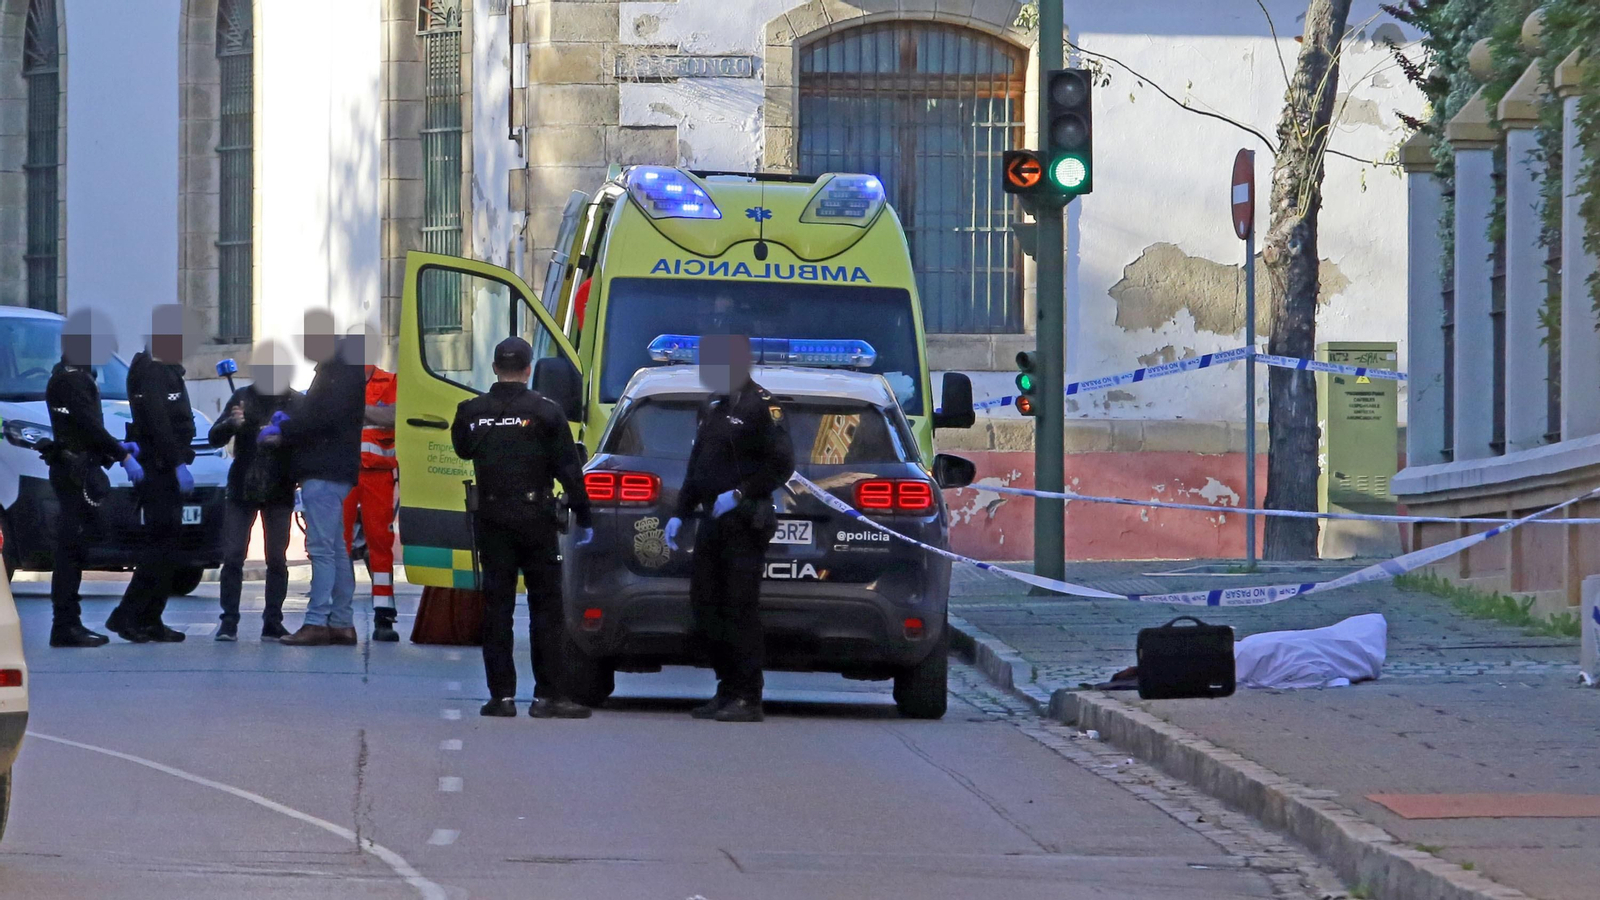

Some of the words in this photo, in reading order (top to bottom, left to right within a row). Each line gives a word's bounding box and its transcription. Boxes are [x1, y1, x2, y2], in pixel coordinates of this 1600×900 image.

[479, 417, 521, 426] POLICIA
[836, 530, 890, 542] @policia
[1225, 589, 1251, 600] PASAR
[1253, 588, 1266, 596] NO
